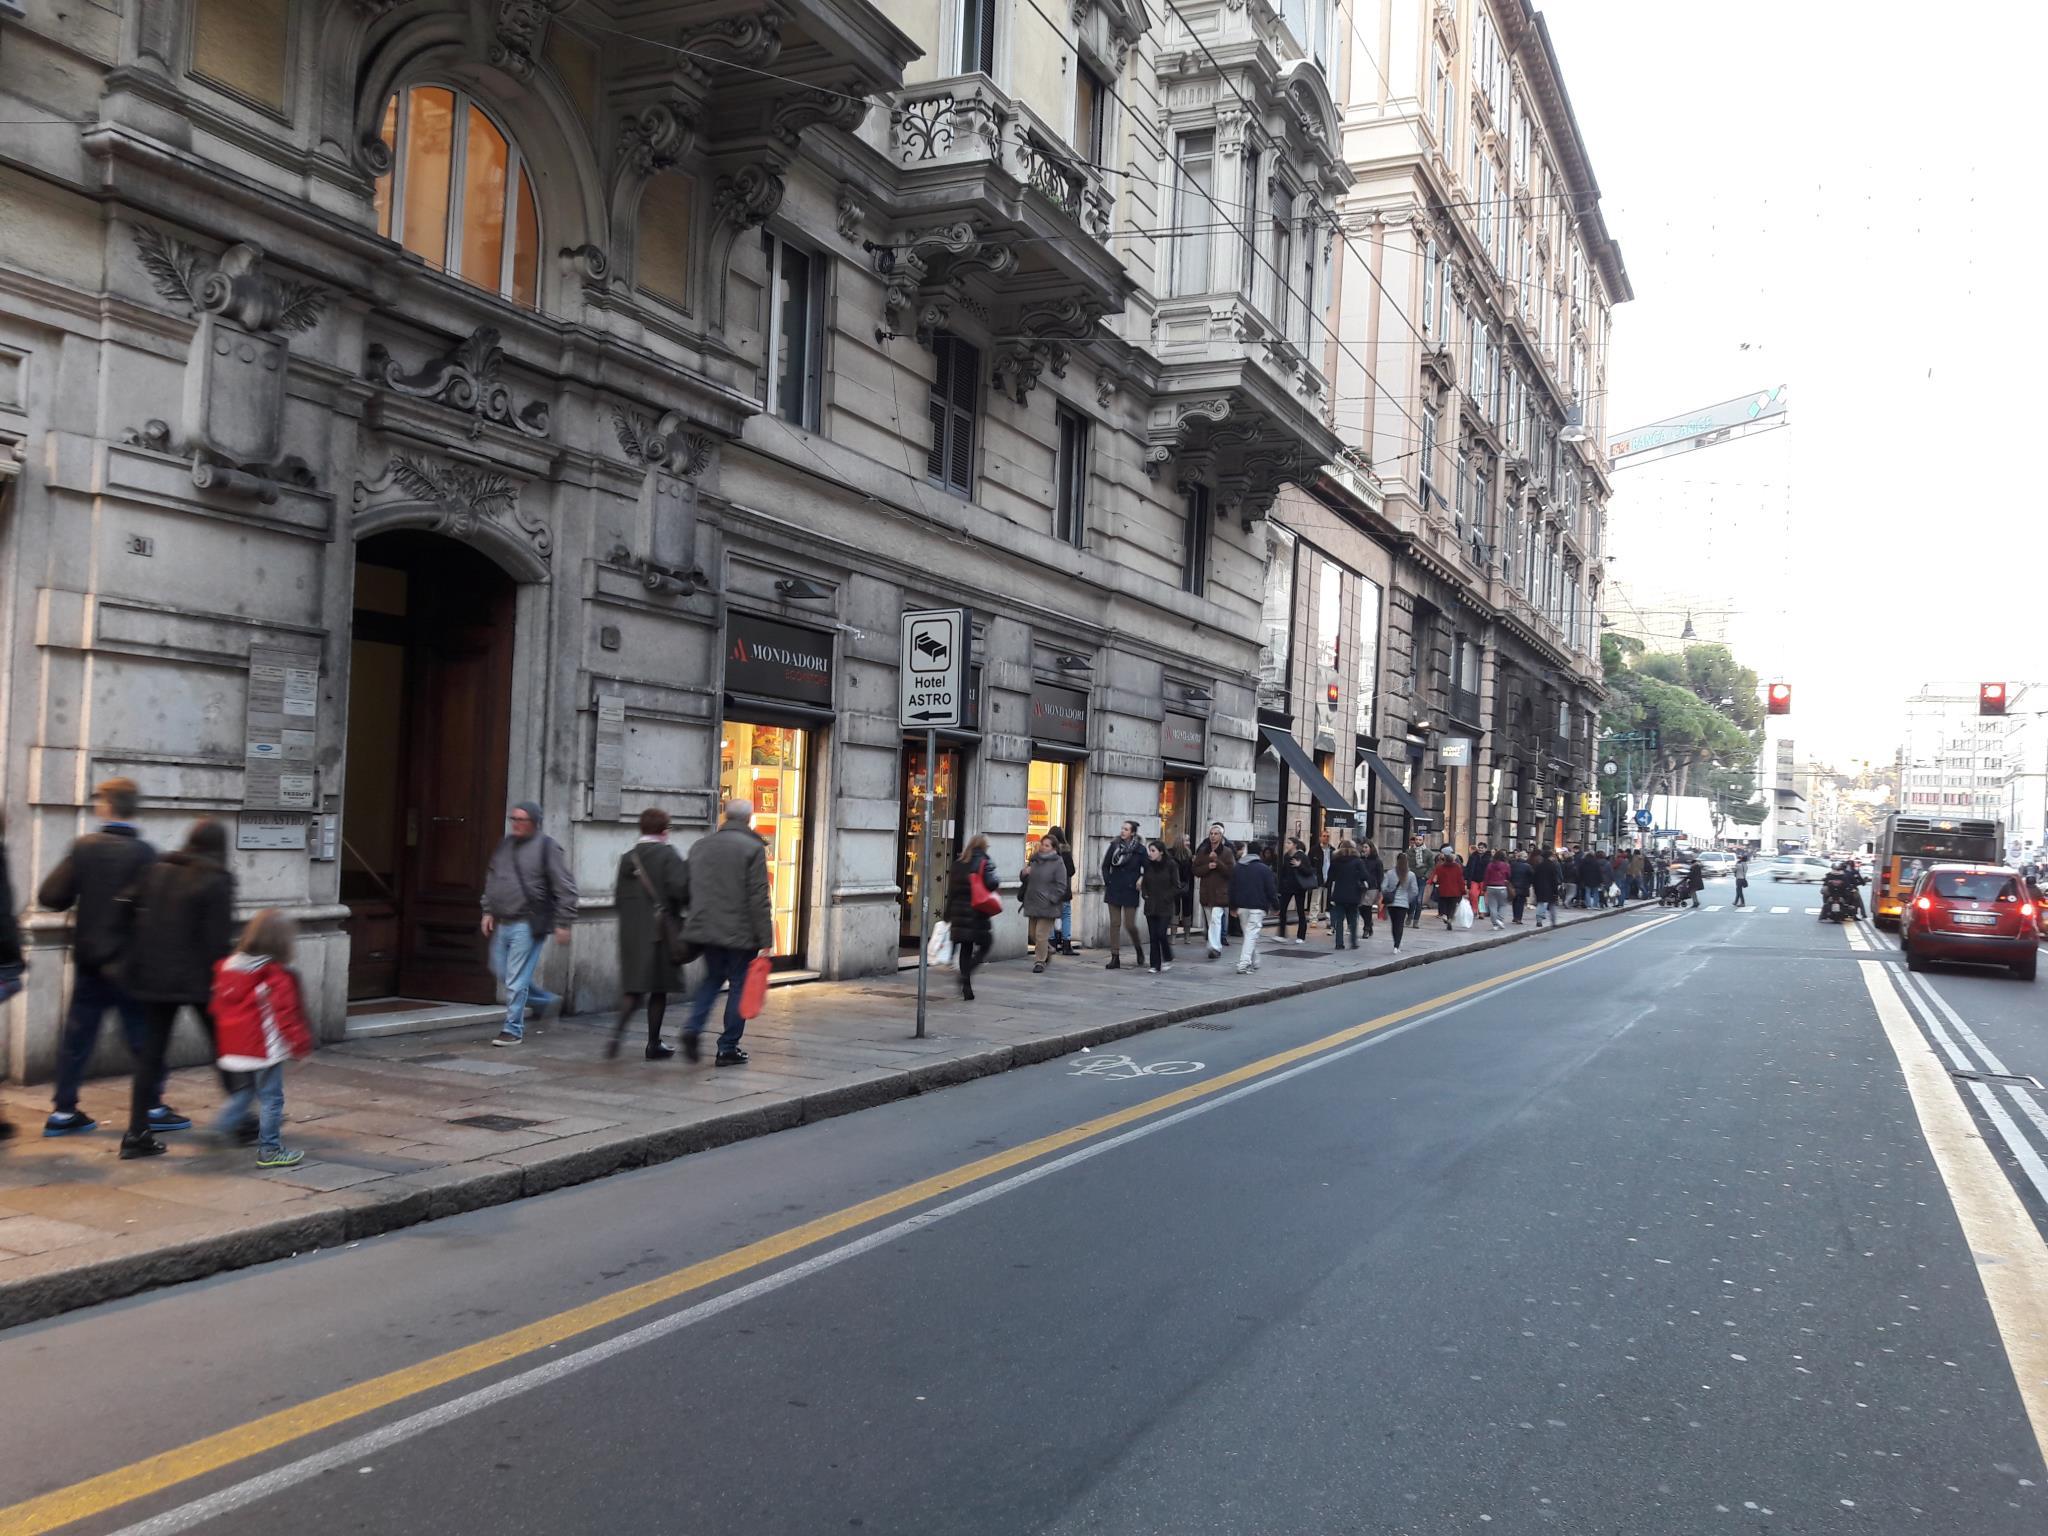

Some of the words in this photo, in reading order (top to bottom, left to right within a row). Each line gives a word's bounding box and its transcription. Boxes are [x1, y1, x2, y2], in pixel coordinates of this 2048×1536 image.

[751, 643, 828, 672] MONDADORI
[915, 675, 946, 688] Hotel
[908, 692, 952, 706] ASTRO
[1044, 703, 1085, 721] MONDADORI
[240, 815, 268, 824] HOTEL
[271, 815, 305, 826] ASTRO
